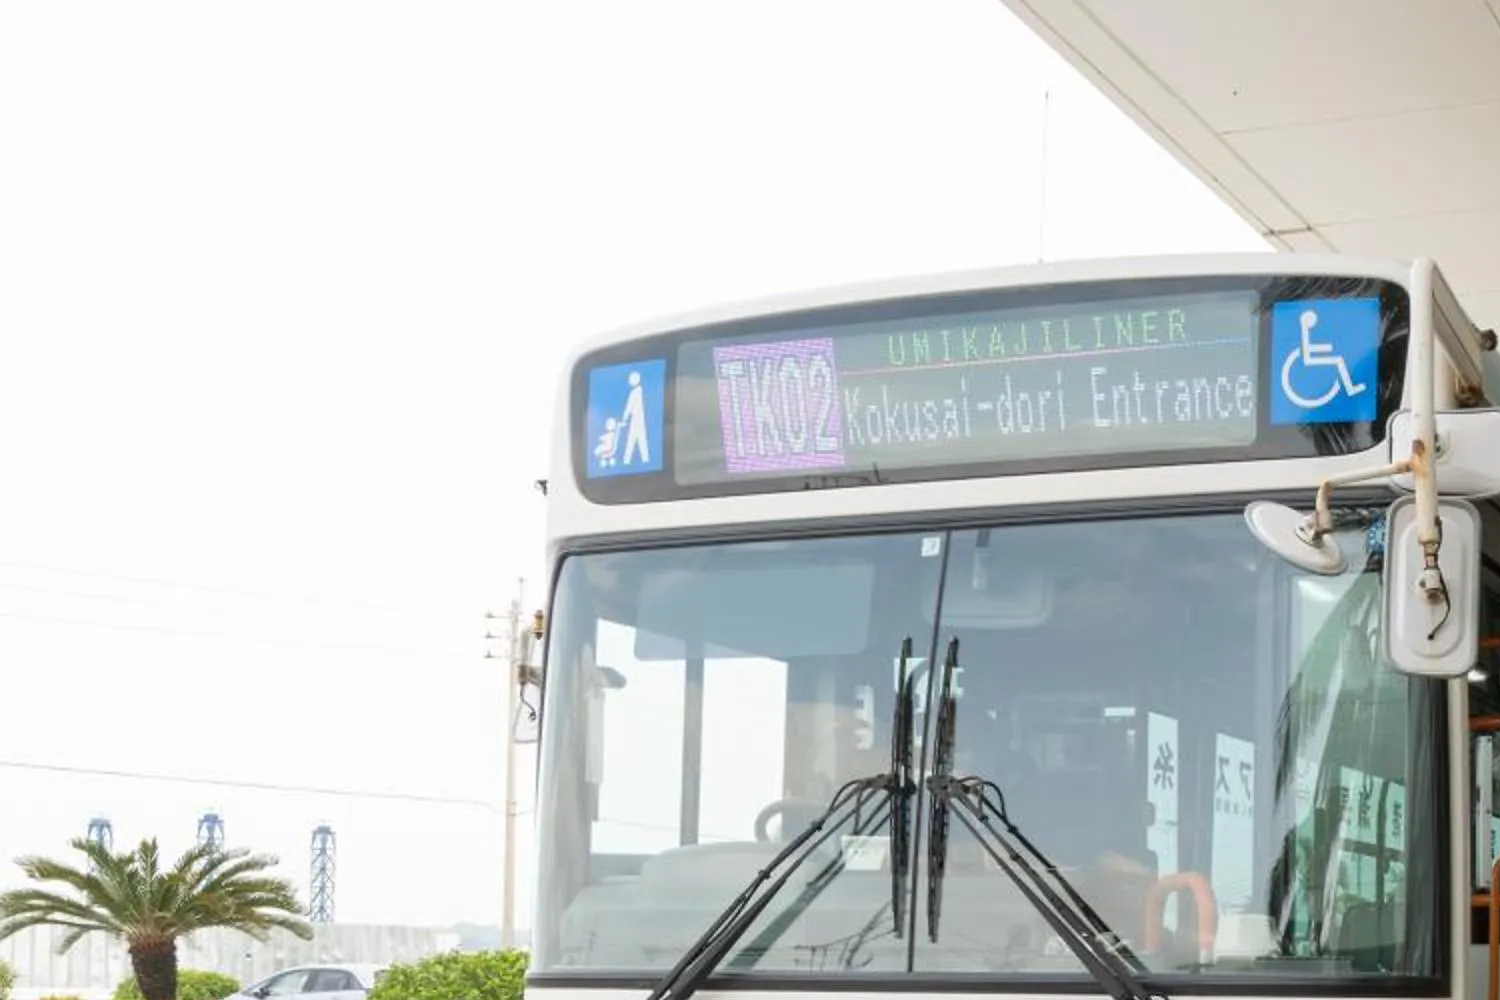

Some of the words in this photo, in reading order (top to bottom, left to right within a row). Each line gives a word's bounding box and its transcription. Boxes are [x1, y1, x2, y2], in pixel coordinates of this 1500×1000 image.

[888, 308, 1187, 366] UMIKAJILINER
[719, 354, 839, 458] TK02
[845, 369, 1067, 446] Kokusai-dori
[1090, 366, 1254, 428] Entrance
